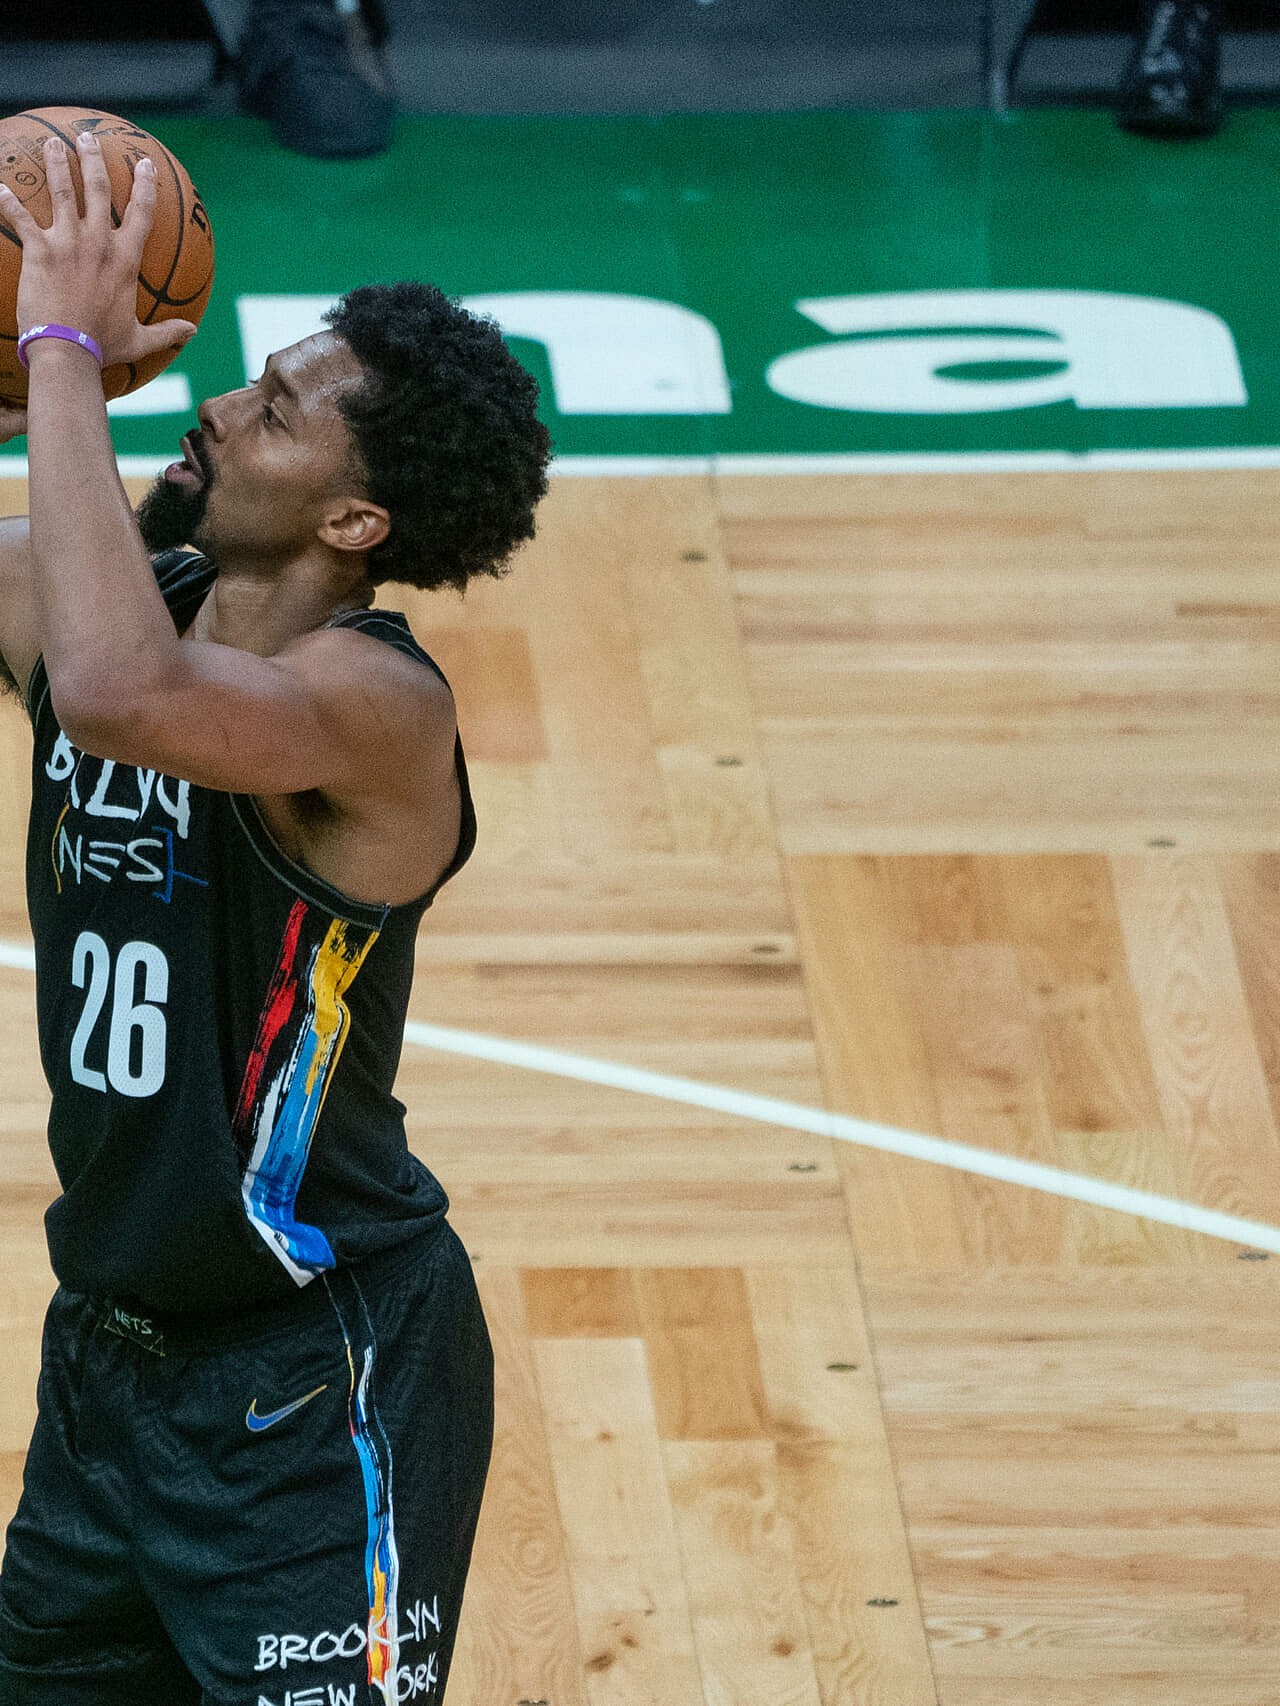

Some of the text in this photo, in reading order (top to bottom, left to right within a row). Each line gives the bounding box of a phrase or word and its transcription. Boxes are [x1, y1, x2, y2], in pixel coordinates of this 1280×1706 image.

[70, 931, 169, 1097] 26
[114, 1307, 153, 1335] NETS
[253, 1595, 441, 1671] BROOKLYN
